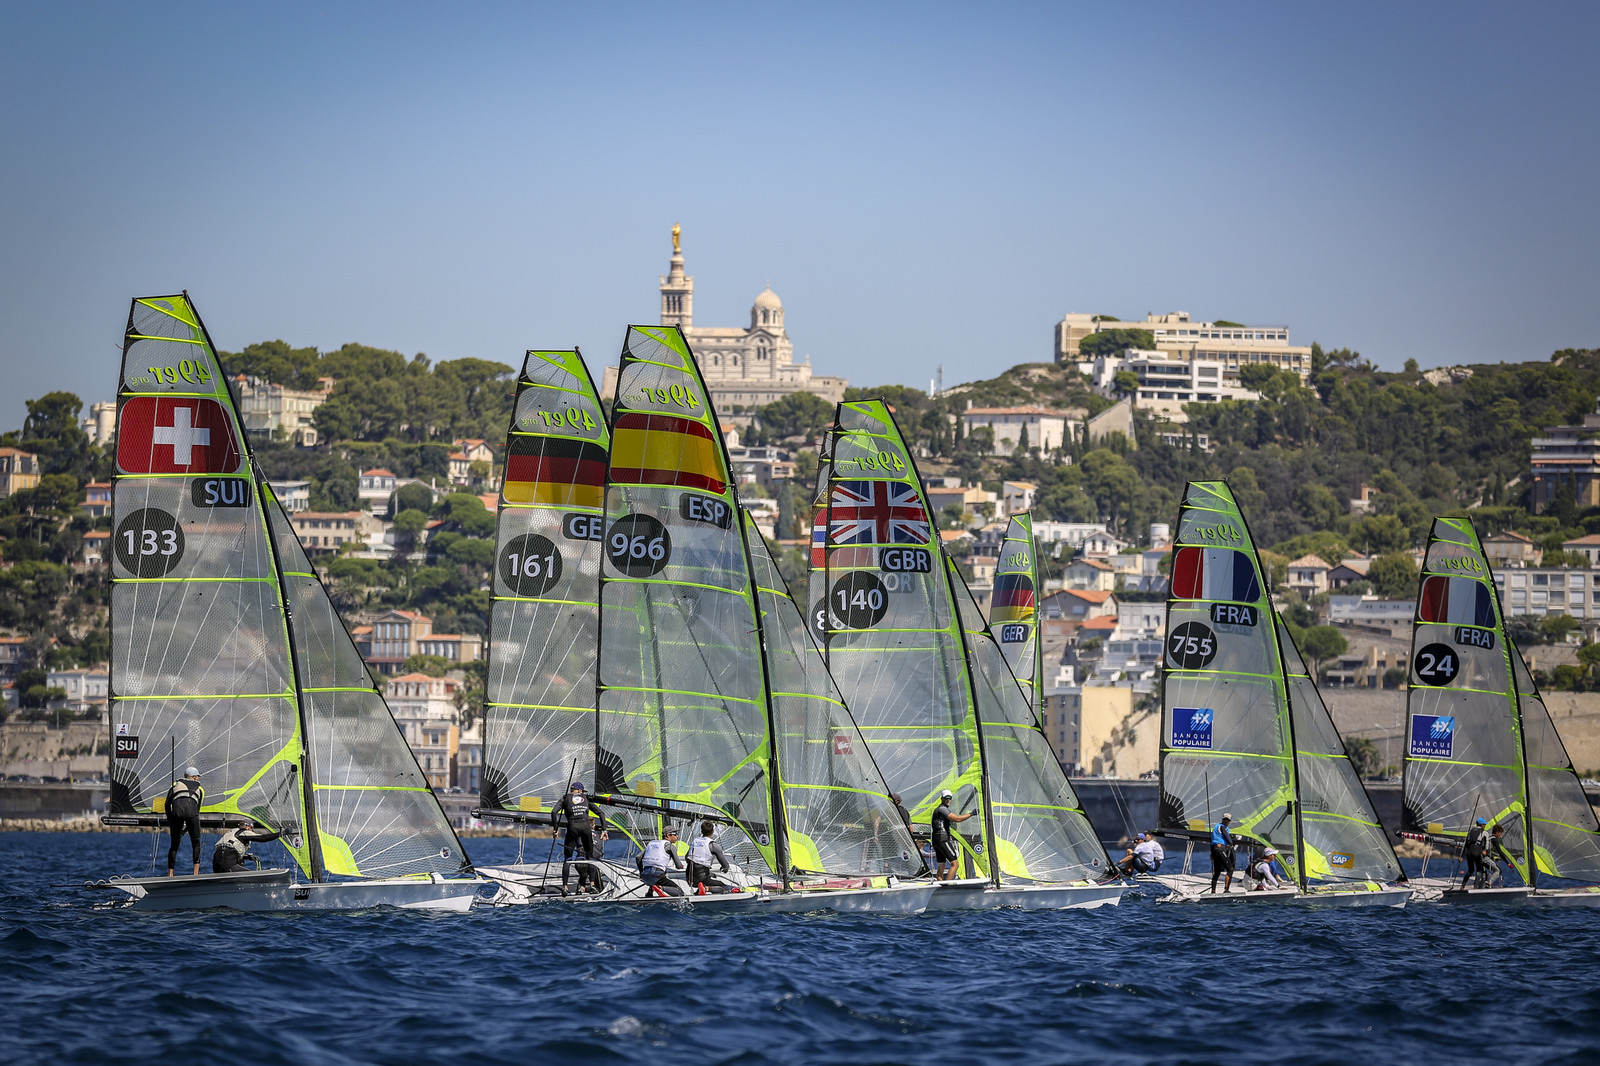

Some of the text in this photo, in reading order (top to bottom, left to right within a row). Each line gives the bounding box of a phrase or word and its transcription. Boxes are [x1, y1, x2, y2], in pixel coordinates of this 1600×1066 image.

[205, 480, 244, 505] SUI
[689, 496, 725, 524] ESP
[569, 516, 602, 539] GE
[123, 529, 178, 556] 133
[611, 533, 665, 560] 966
[508, 553, 554, 578] 161
[885, 550, 928, 571] GBR
[880, 572, 912, 592] OR
[837, 589, 883, 611] 140
[1216, 605, 1253, 625] FRA
[1003, 625, 1024, 641] GER
[1460, 628, 1490, 648] FRA
[1172, 635, 1212, 656] 755
[1419, 653, 1454, 677] 24
[1173, 732, 1210, 740] BANQUE
[1173, 739, 1210, 747] POPULAIRE
[1413, 740, 1450, 748] BANQUE
[1412, 747, 1450, 755] POPULAIRE
[1332, 855, 1347, 864] SAP
